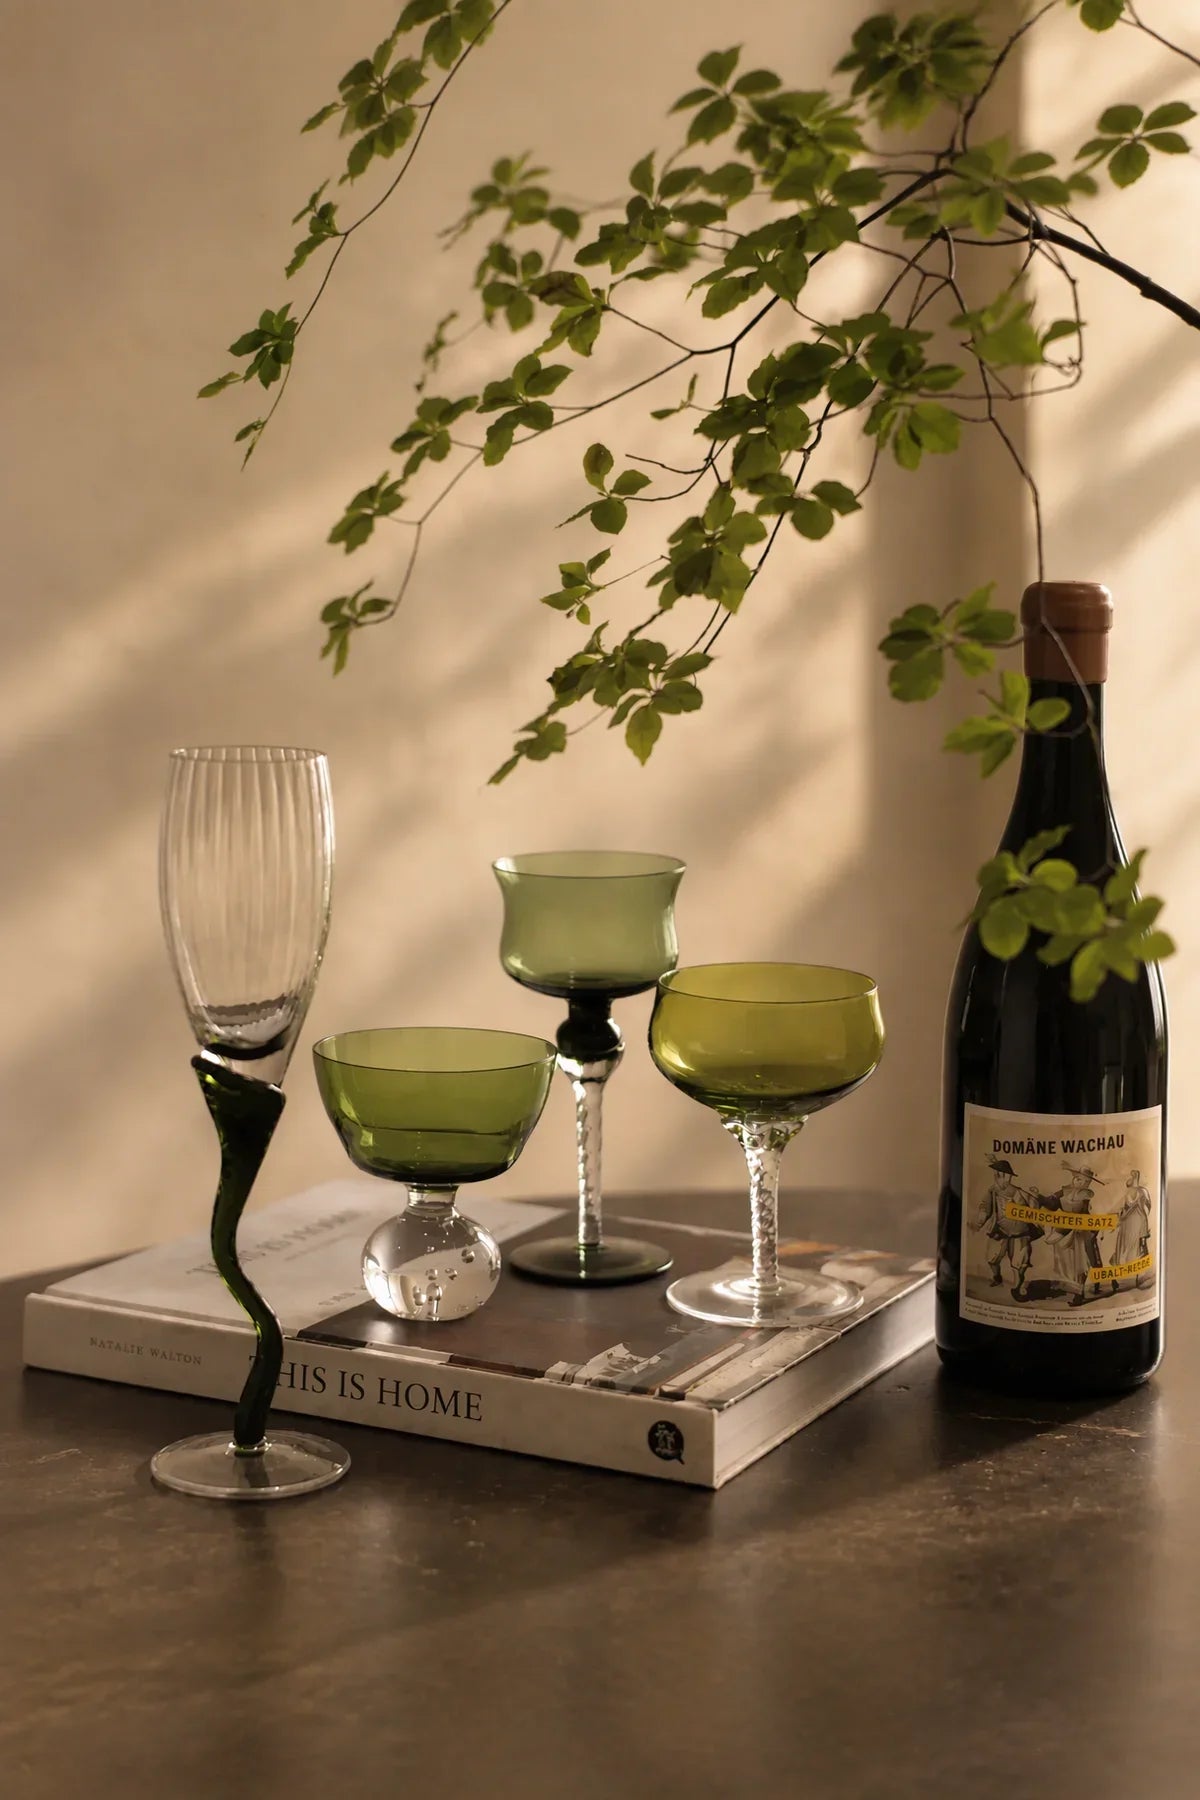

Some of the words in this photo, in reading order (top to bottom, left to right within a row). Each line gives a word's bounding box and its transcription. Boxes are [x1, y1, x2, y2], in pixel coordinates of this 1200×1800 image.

[993, 1138, 1057, 1155] DOMÄNE
[1061, 1134, 1125, 1153] WACHAU
[1011, 1207, 1083, 1226] GEMISCHTER
[1087, 1217, 1113, 1227] SATZ
[89, 1336, 144, 1356] NATALIE
[150, 1347, 202, 1366] WALTON
[249, 1355, 327, 1394] HIS
[338, 1370, 365, 1401] IS
[377, 1377, 483, 1422] HOME
